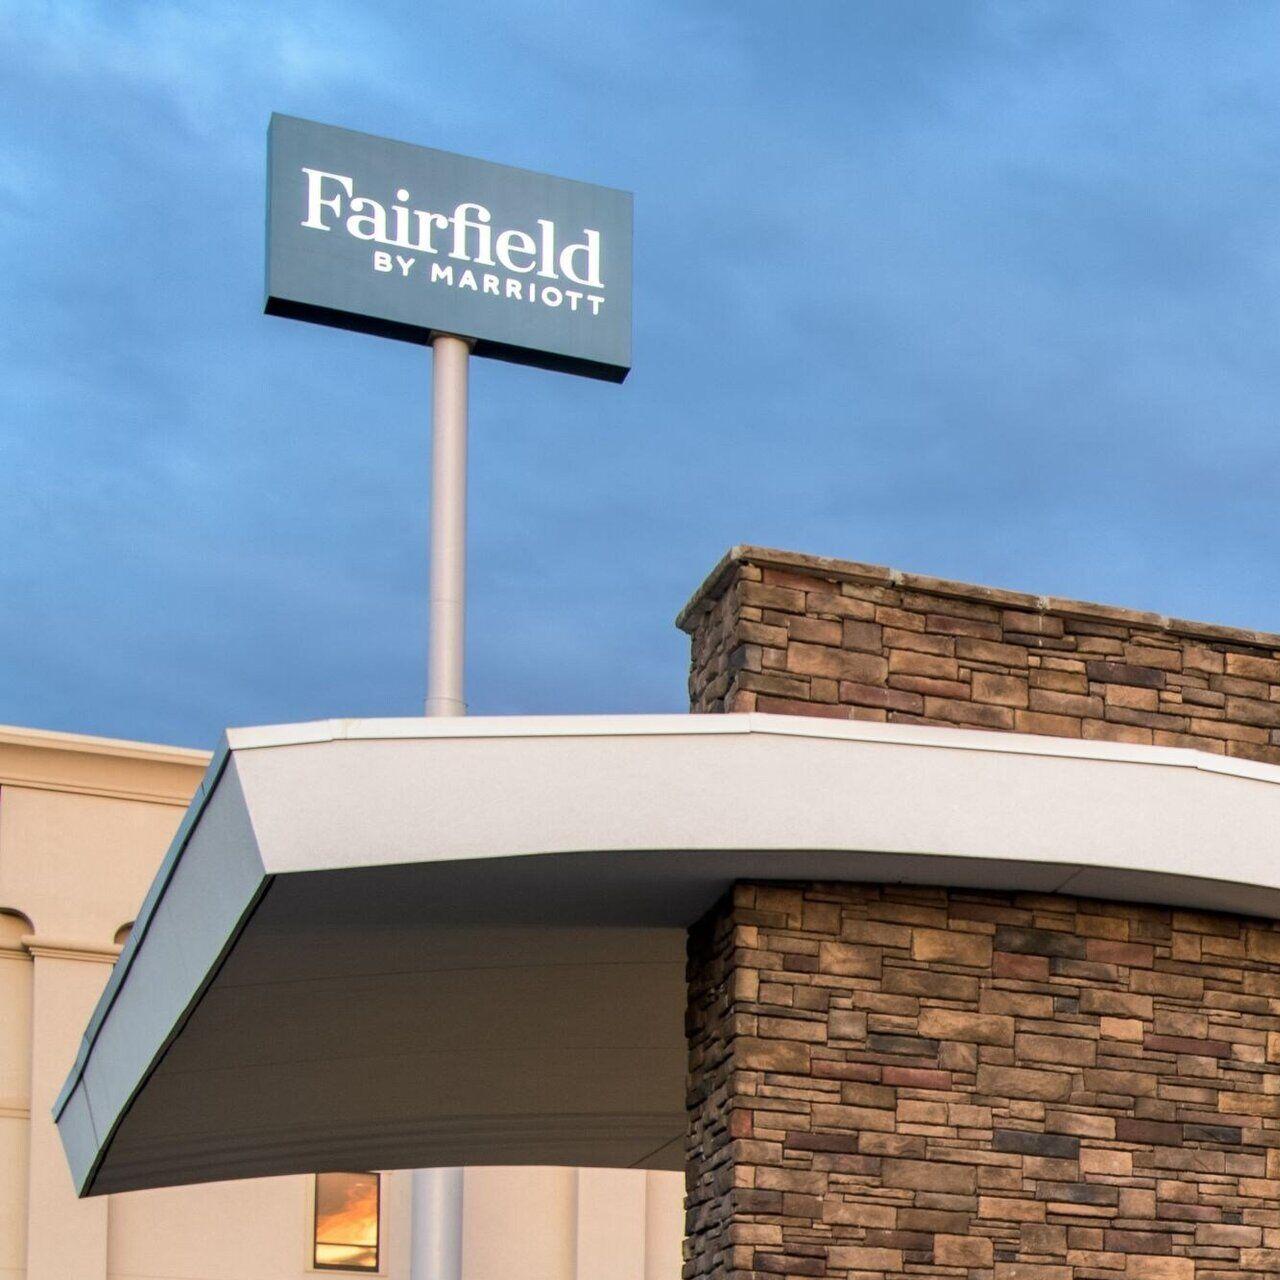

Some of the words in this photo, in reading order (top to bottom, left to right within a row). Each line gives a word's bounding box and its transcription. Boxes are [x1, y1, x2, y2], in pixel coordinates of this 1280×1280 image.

[300, 167, 605, 288] Fairfield
[373, 250, 416, 277] BY
[430, 262, 605, 316] MARRIOTT
